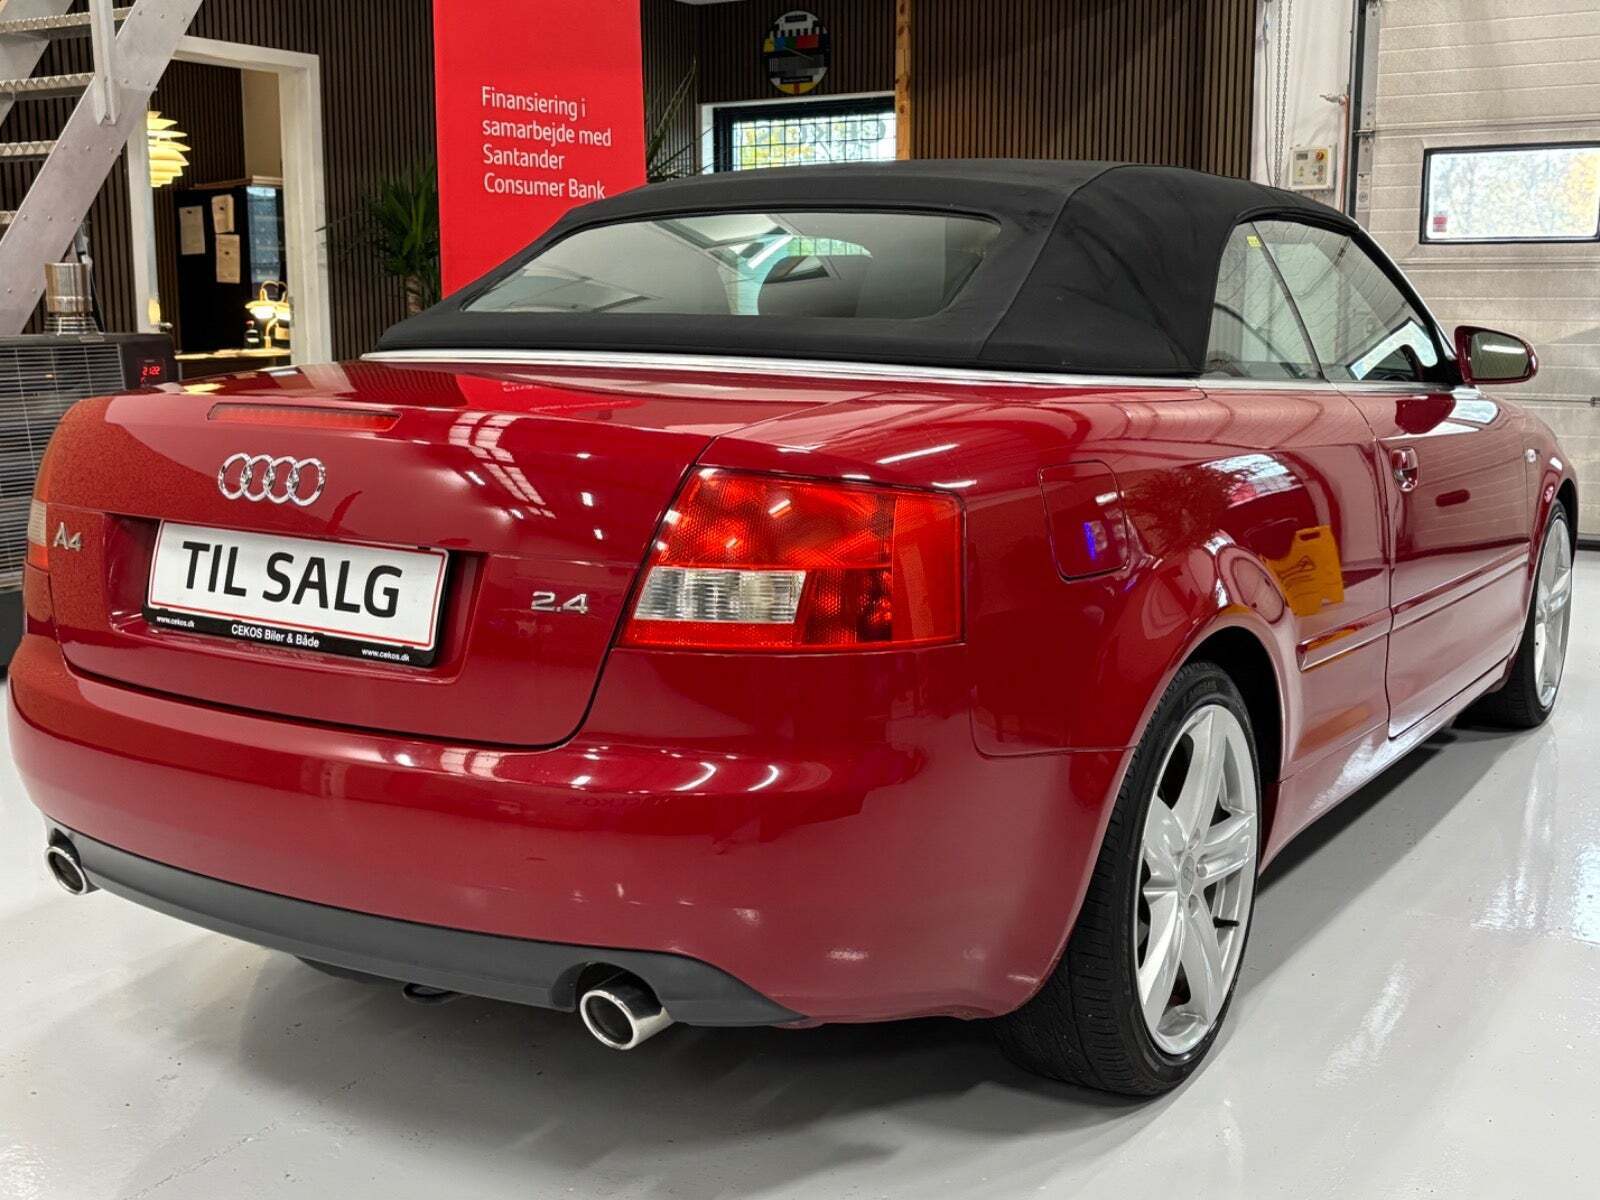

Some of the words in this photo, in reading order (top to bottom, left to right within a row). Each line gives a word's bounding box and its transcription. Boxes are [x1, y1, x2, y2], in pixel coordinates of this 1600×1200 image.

[482, 86, 577, 121] Finansiering
[581, 98, 586, 117] i
[482, 119, 575, 147] samarbejde
[579, 128, 612, 147] med
[483, 144, 565, 169] Santander
[484, 172, 565, 197] Consumer
[569, 178, 606, 200] Bank
[53, 521, 81, 551] A4
[182, 541, 247, 597] TIL
[261, 551, 403, 618] SALG
[531, 591, 588, 614] 2.4
[231, 624, 263, 639] CEKOS
[264, 629, 285, 642] Biler
[286, 633, 294, 644] &
[296, 633, 320, 648] Både
[361, 648, 410, 662] www.cekos.dk
